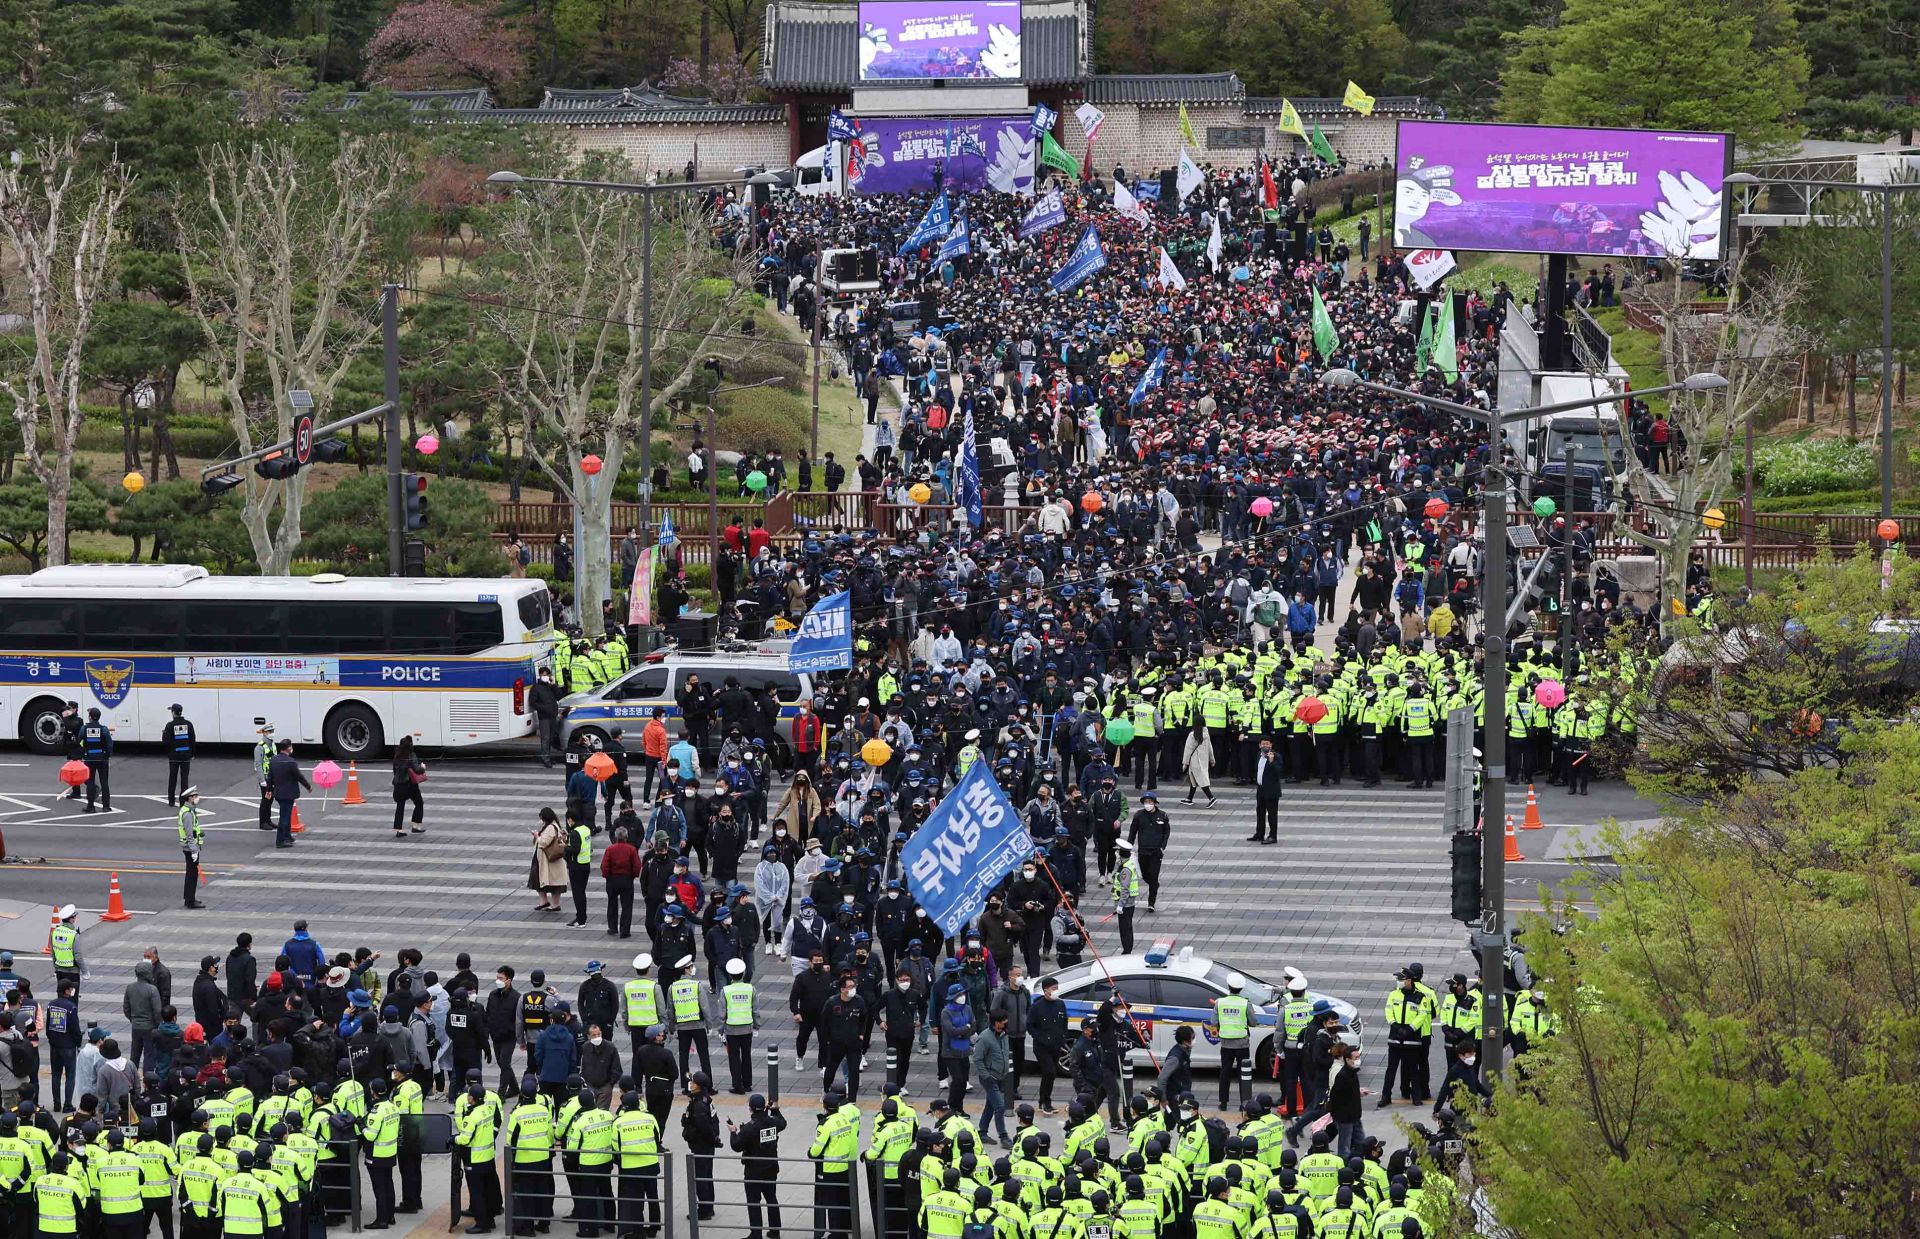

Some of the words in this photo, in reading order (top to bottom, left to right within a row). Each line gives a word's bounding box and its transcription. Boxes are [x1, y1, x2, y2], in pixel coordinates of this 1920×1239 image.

[300, 430, 309, 451] 50
[206, 659, 232, 668] 사람이
[236, 659, 261, 669] 보이면
[265, 659, 282, 669] 일단
[285, 660, 307, 669] 멈춤!
[382, 666, 441, 681] POLICE
[614, 707, 643, 716] 방송조명
[645, 707, 654, 715] 92
[524, 1117, 547, 1125] POLICE
[588, 1125, 613, 1136] POLICE
[40, 1190, 66, 1198] POLICE
[931, 1211, 957, 1219] POLICE
[1198, 1220, 1223, 1228] POLICE
